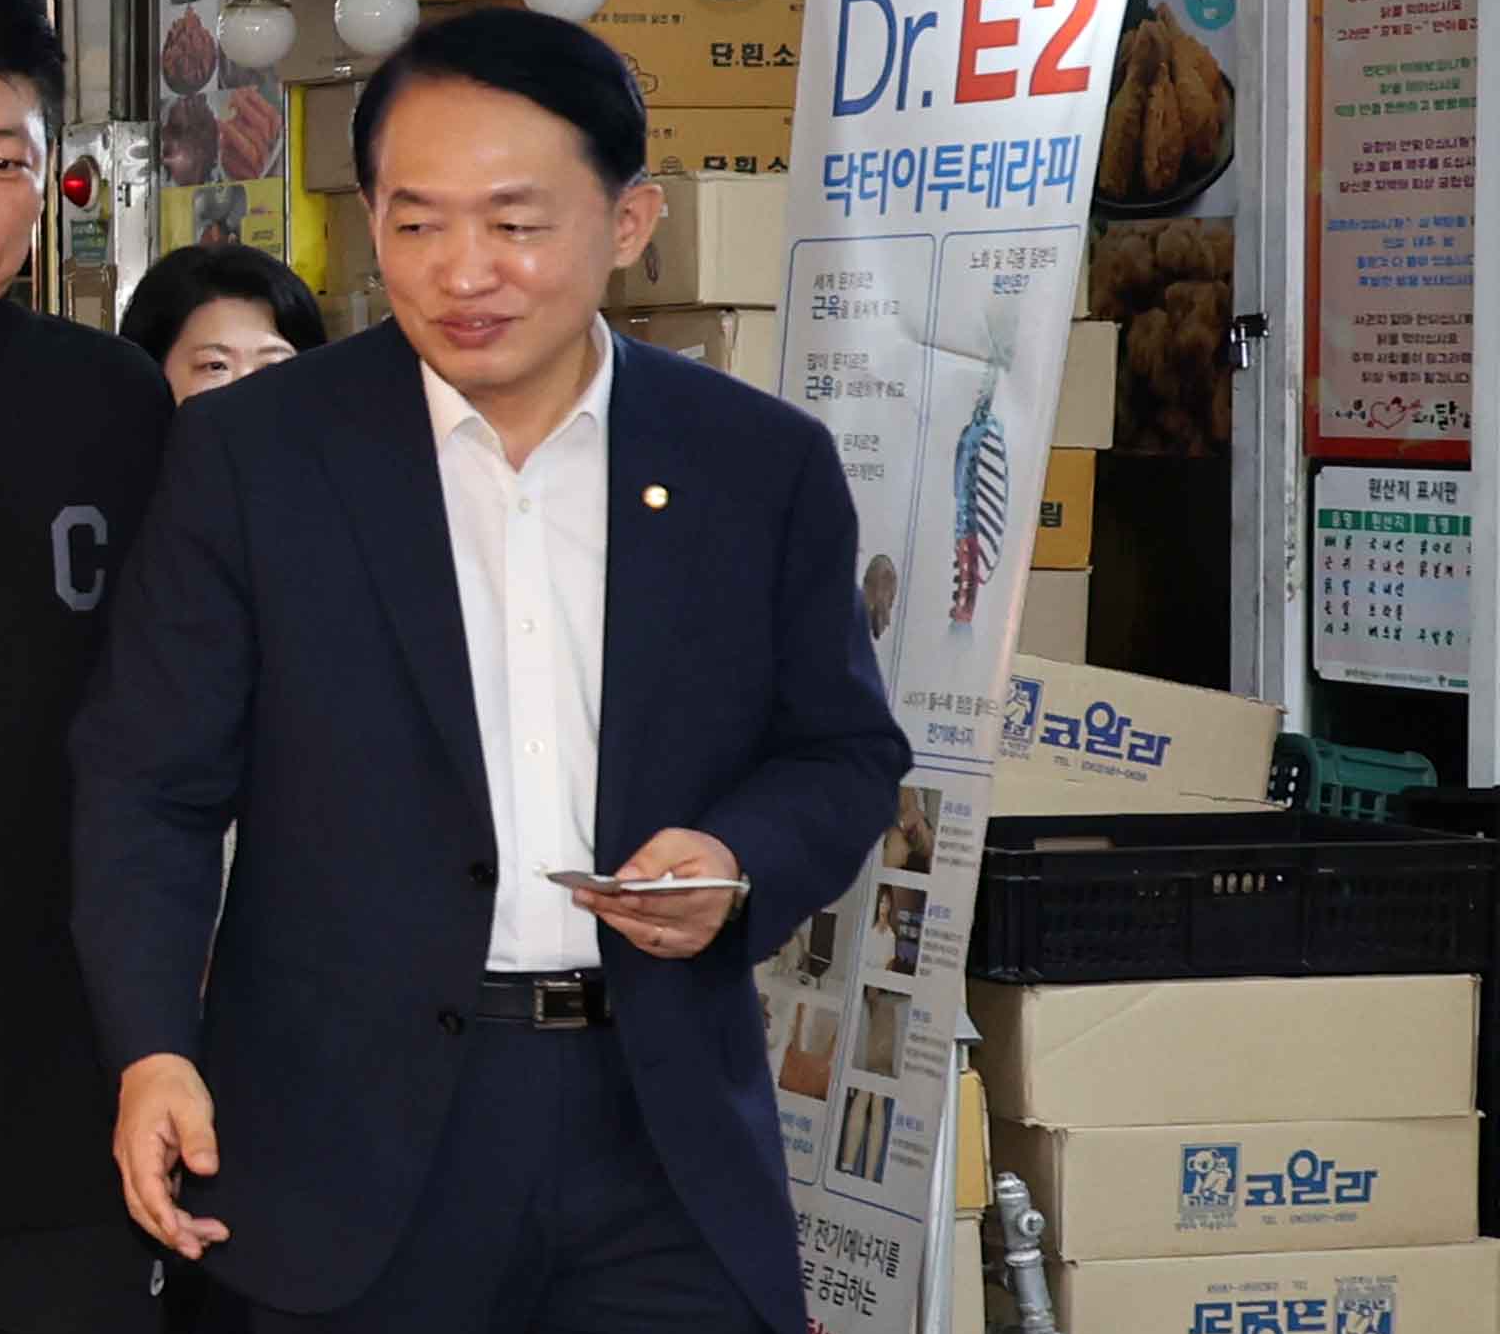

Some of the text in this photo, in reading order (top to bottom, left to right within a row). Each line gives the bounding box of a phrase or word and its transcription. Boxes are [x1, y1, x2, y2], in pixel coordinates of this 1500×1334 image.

[822, 133, 1085, 218] 닥터이투테라피
[1368, 478, 1458, 503] 원산지 표시판
[52, 504, 107, 610] C
[1040, 701, 1172, 767] 코알라
[1245, 1149, 1378, 1206] 코알라
[813, 1217, 900, 1278] 전기에너지를
[818, 1266, 878, 1317] 공급하는
